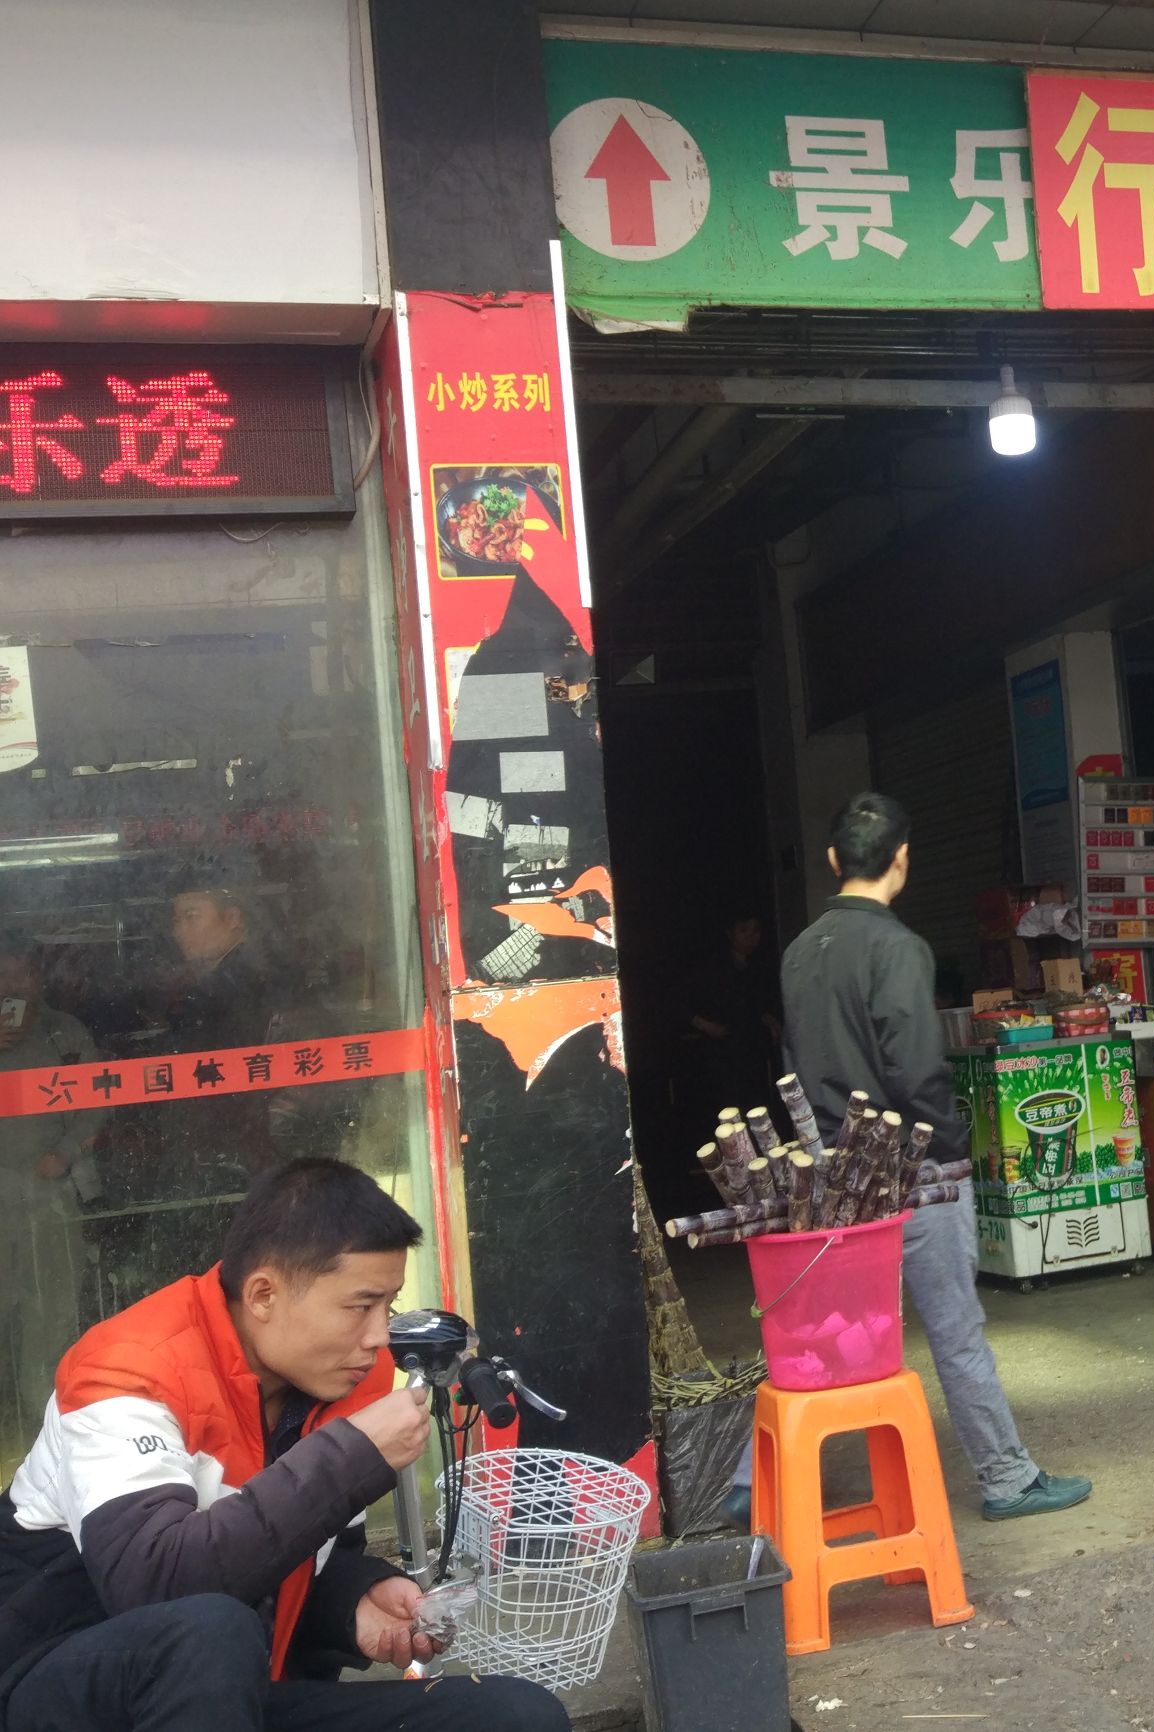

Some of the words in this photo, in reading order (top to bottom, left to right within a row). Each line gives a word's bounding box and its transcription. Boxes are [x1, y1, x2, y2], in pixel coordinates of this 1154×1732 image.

[427, 371, 551, 413] 小炒系列
[91, 1040, 372, 1099] 中国体育彩票
